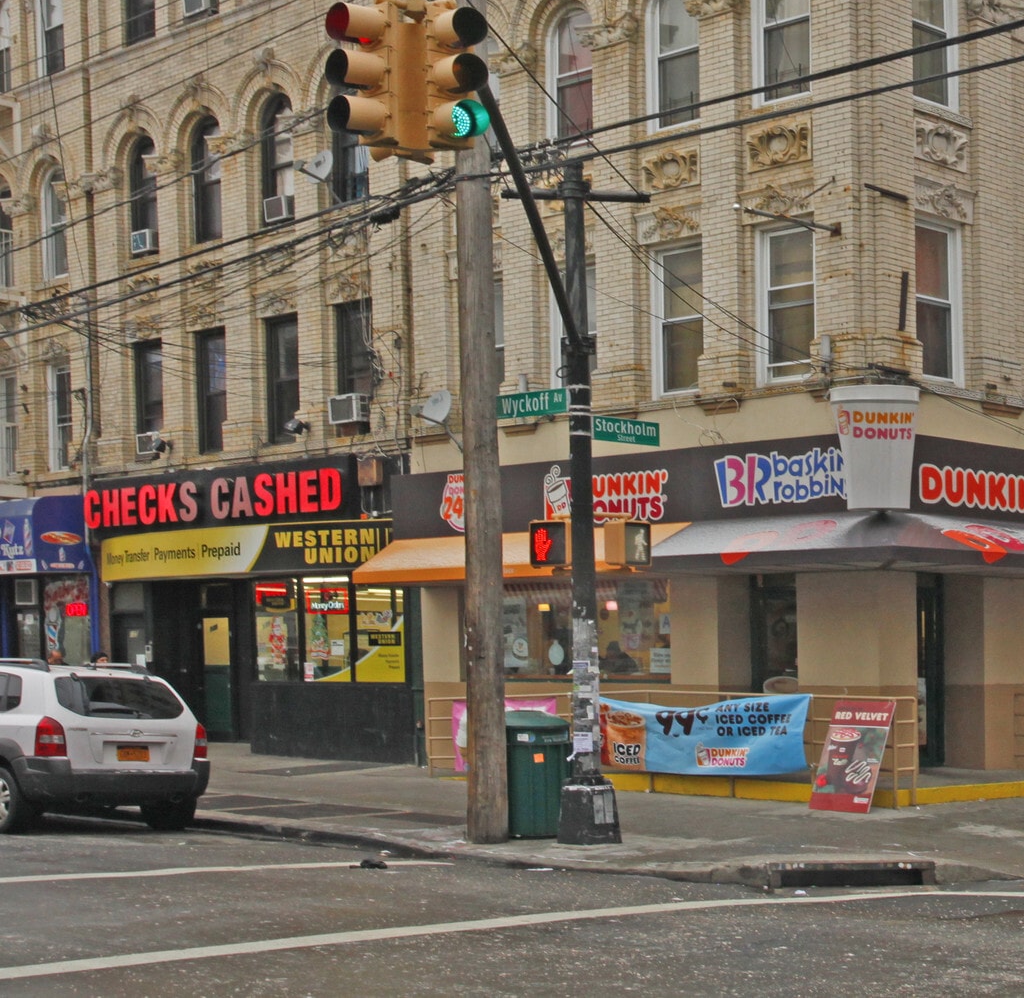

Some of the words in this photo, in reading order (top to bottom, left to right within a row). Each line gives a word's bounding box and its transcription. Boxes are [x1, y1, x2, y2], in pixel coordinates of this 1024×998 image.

[501, 392, 549, 418] Wyckoff
[553, 392, 563, 403] Av
[853, 410, 914, 424] DUNKIN'
[595, 418, 656, 437] Stockholm
[852, 427, 912, 440] DONUTS
[617, 434, 635, 443] Street
[592, 470, 667, 497] UNKIN'
[774, 476, 847, 501] robbin
[84, 481, 198, 529] CHECKS
[211, 468, 342, 520] CASHED
[593, 496, 662, 520] ONUTS
[274, 528, 375, 548] WESTERN
[106, 552, 124, 567] Money
[125, 549, 150, 563] Transfer
[153, 547, 196, 563] Payments
[201, 542, 241, 560] Prepaid
[304, 546, 375, 565] UNION
[715, 704, 738, 713] ANY
[743, 702, 769, 713] SIZE
[715, 714, 743, 725] ICED
[747, 714, 792, 724] COFFEE
[834, 711, 853, 721] RED
[855, 712, 889, 721] VELVET
[717, 727, 733, 737] OR
[737, 726, 766, 737] ICED
[769, 725, 788, 736] TEA
[613, 743, 641, 756] ICED
[614, 755, 641, 765] COFFEE
[711, 757, 745, 766] DONUTS
